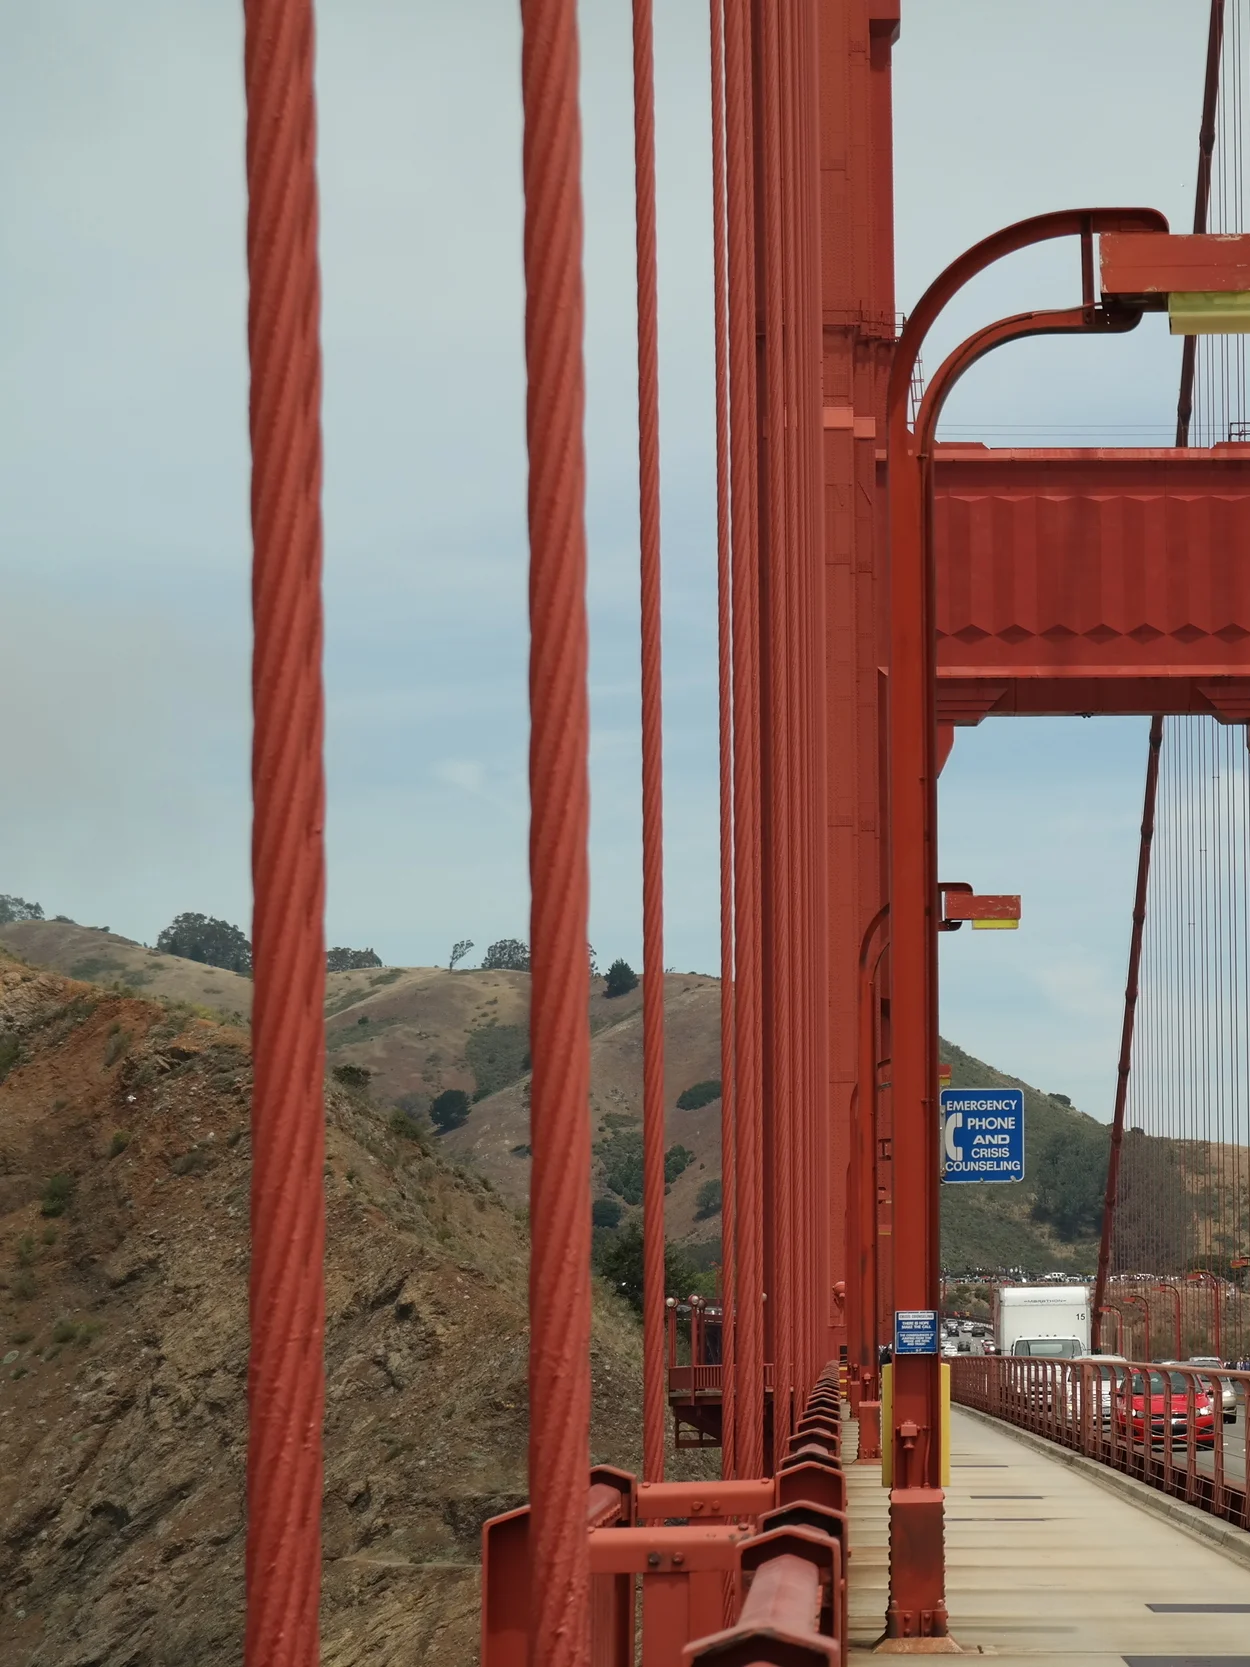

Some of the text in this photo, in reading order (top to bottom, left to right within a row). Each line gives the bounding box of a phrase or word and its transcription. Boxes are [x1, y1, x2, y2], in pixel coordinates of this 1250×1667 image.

[946, 1100, 1017, 1111] EMERGENCY
[967, 1117, 1016, 1130] PHONE
[972, 1134, 1010, 1145] AND
[971, 1147, 1010, 1158] CRISIS
[945, 1161, 1020, 1172] COUNSELING
